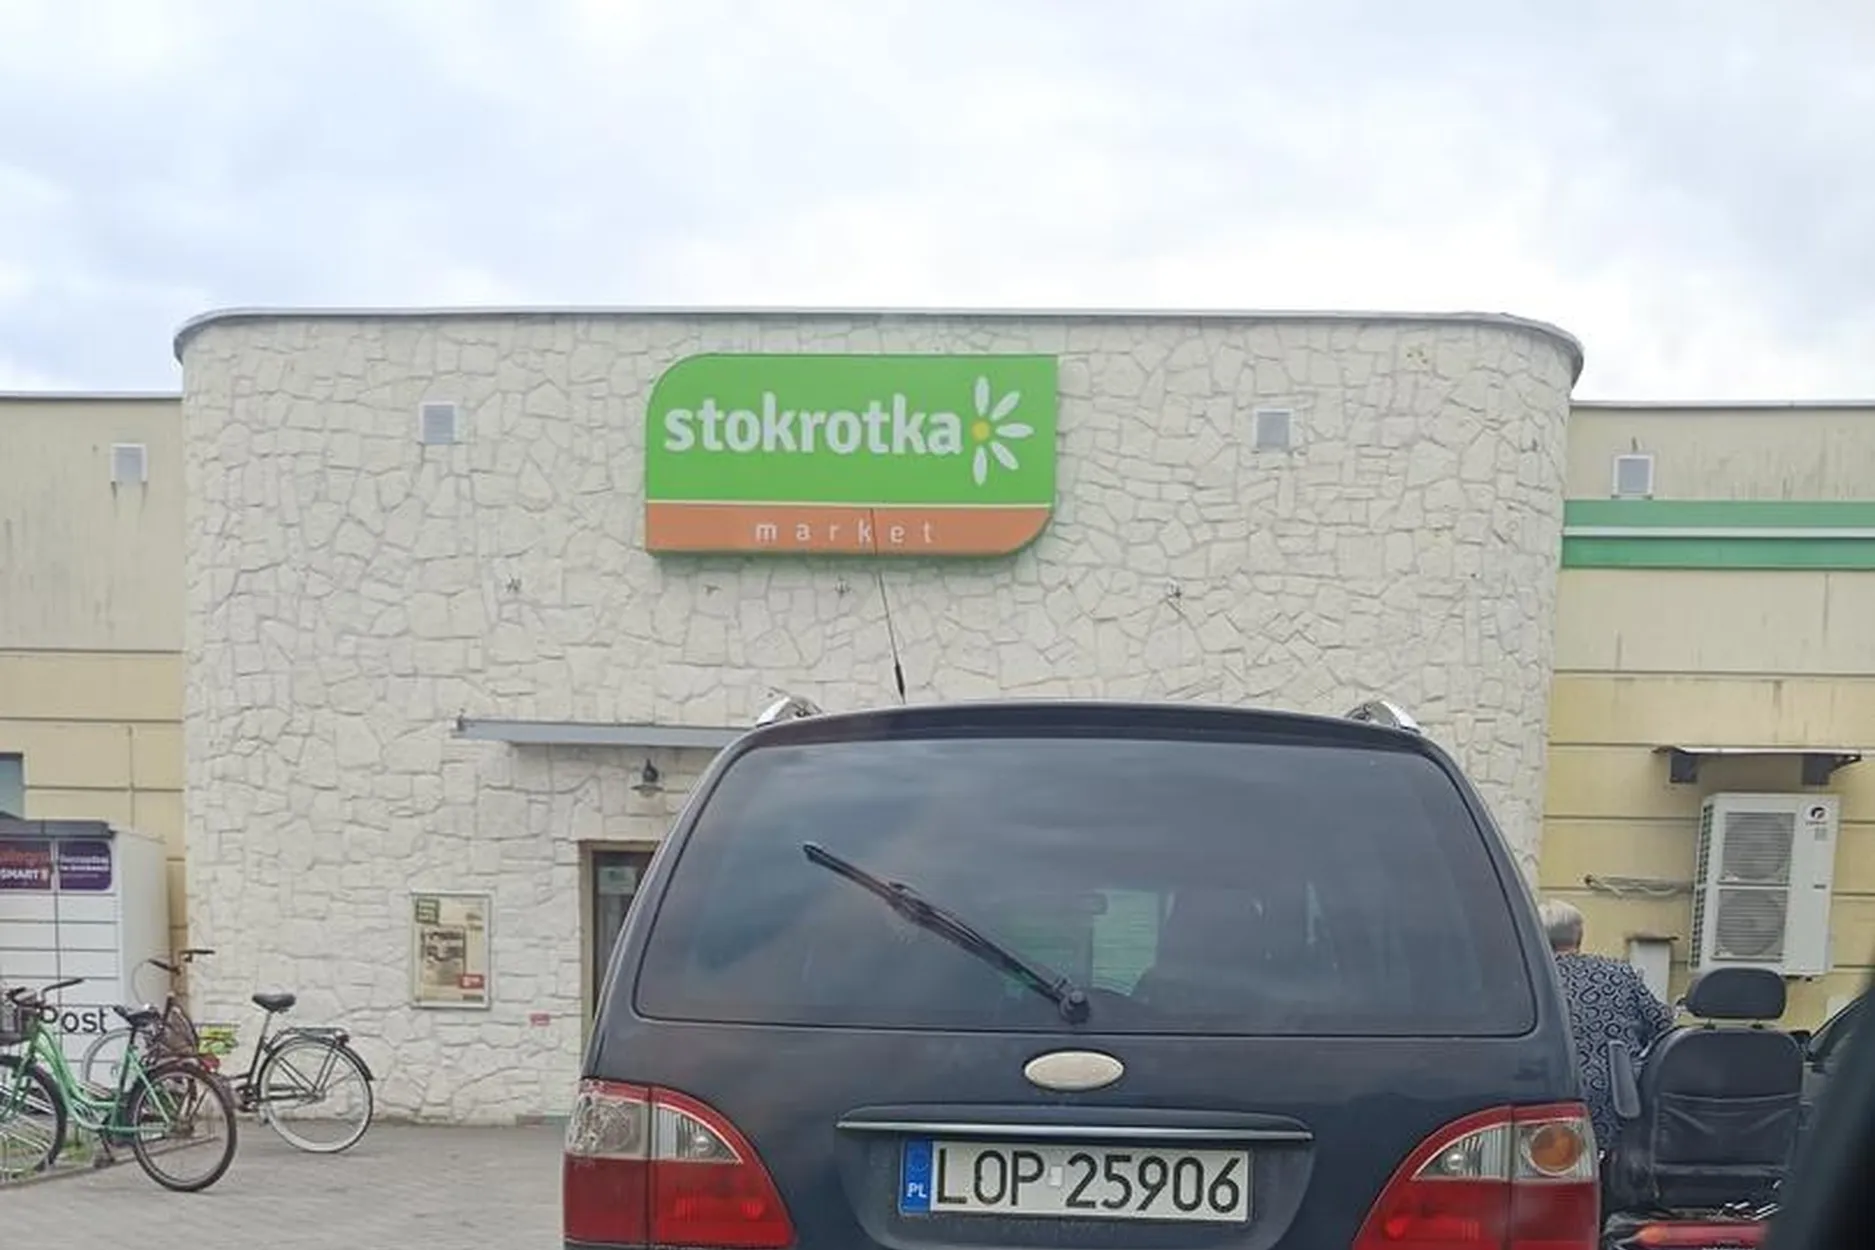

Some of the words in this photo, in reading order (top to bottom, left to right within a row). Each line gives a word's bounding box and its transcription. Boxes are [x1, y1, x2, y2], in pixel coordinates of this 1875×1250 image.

[663, 391, 963, 455] stokrotka
[754, 519, 933, 544] market
[907, 1182, 928, 1199] PL
[936, 1147, 1044, 1206] LOP
[1064, 1152, 1242, 1214] 25906
